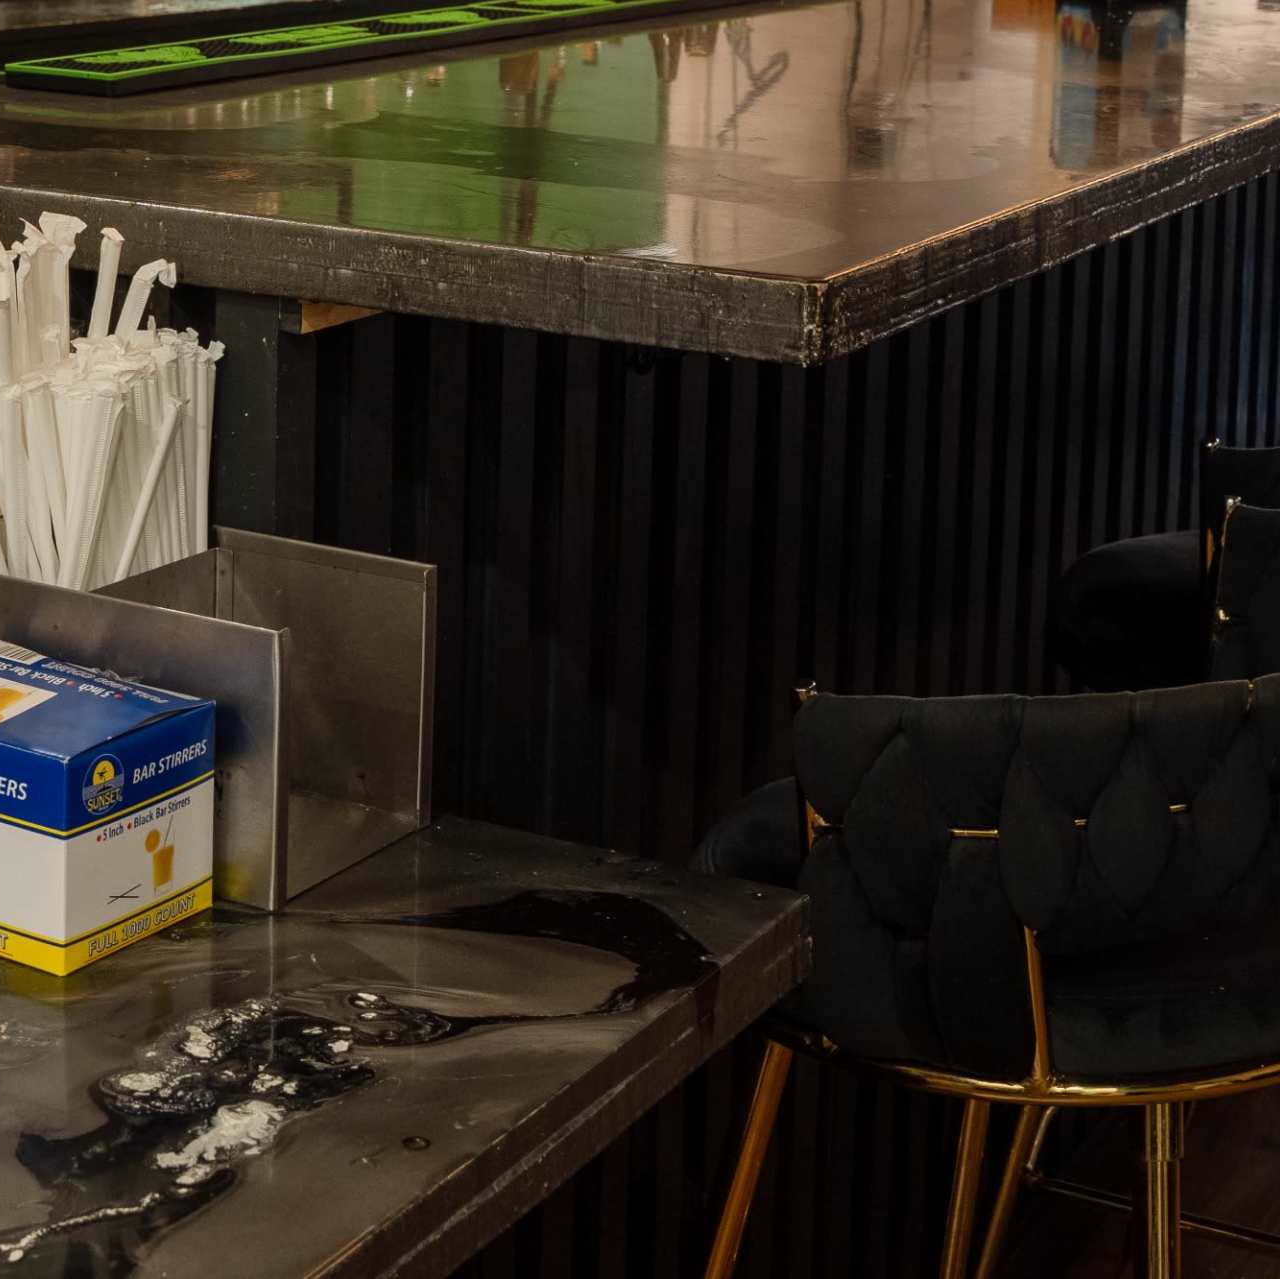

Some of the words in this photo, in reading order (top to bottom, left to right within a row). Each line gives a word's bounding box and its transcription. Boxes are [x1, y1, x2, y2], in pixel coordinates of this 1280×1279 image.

[12, 666, 32, 677] Bar
[31, 670, 68, 686] Black
[77, 682, 101, 695] Inch
[132, 762, 157, 785] BAR
[158, 739, 208, 774] STIRRERS
[87, 788, 122, 812] SUNSET
[102, 830, 108, 841] 5
[108, 823, 124, 839] Inch
[134, 811, 154, 829] Black
[155, 806, 167, 819] Bar
[167, 795, 191, 815] Stirrers
[87, 932, 119, 957] FULL
[121, 917, 152, 942] 1000
[153, 894, 197, 927] COUNT
